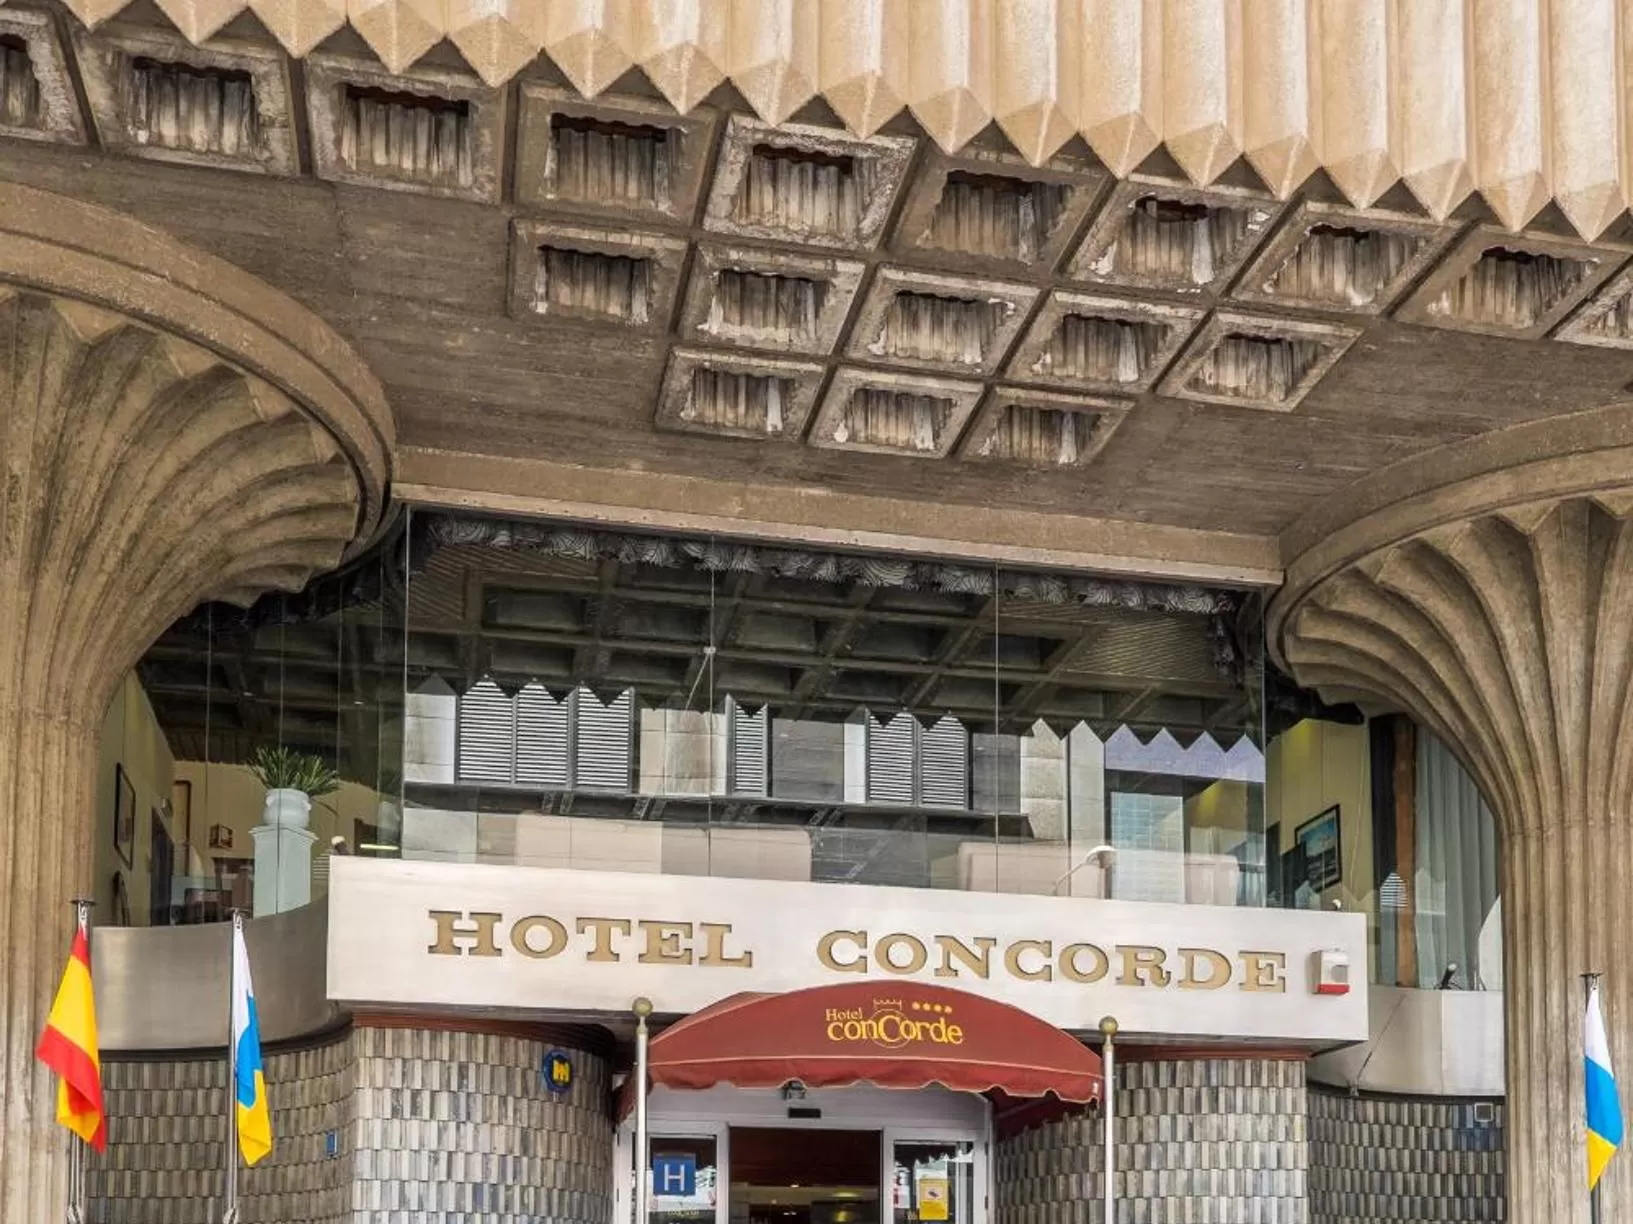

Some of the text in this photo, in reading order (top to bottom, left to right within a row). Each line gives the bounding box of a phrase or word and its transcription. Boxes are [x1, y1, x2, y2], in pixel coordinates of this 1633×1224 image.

[428, 910, 1286, 993] HOTEL CONCORDE
[825, 1007, 863, 1022] Hotel
[664, 1163, 685, 1192] H
